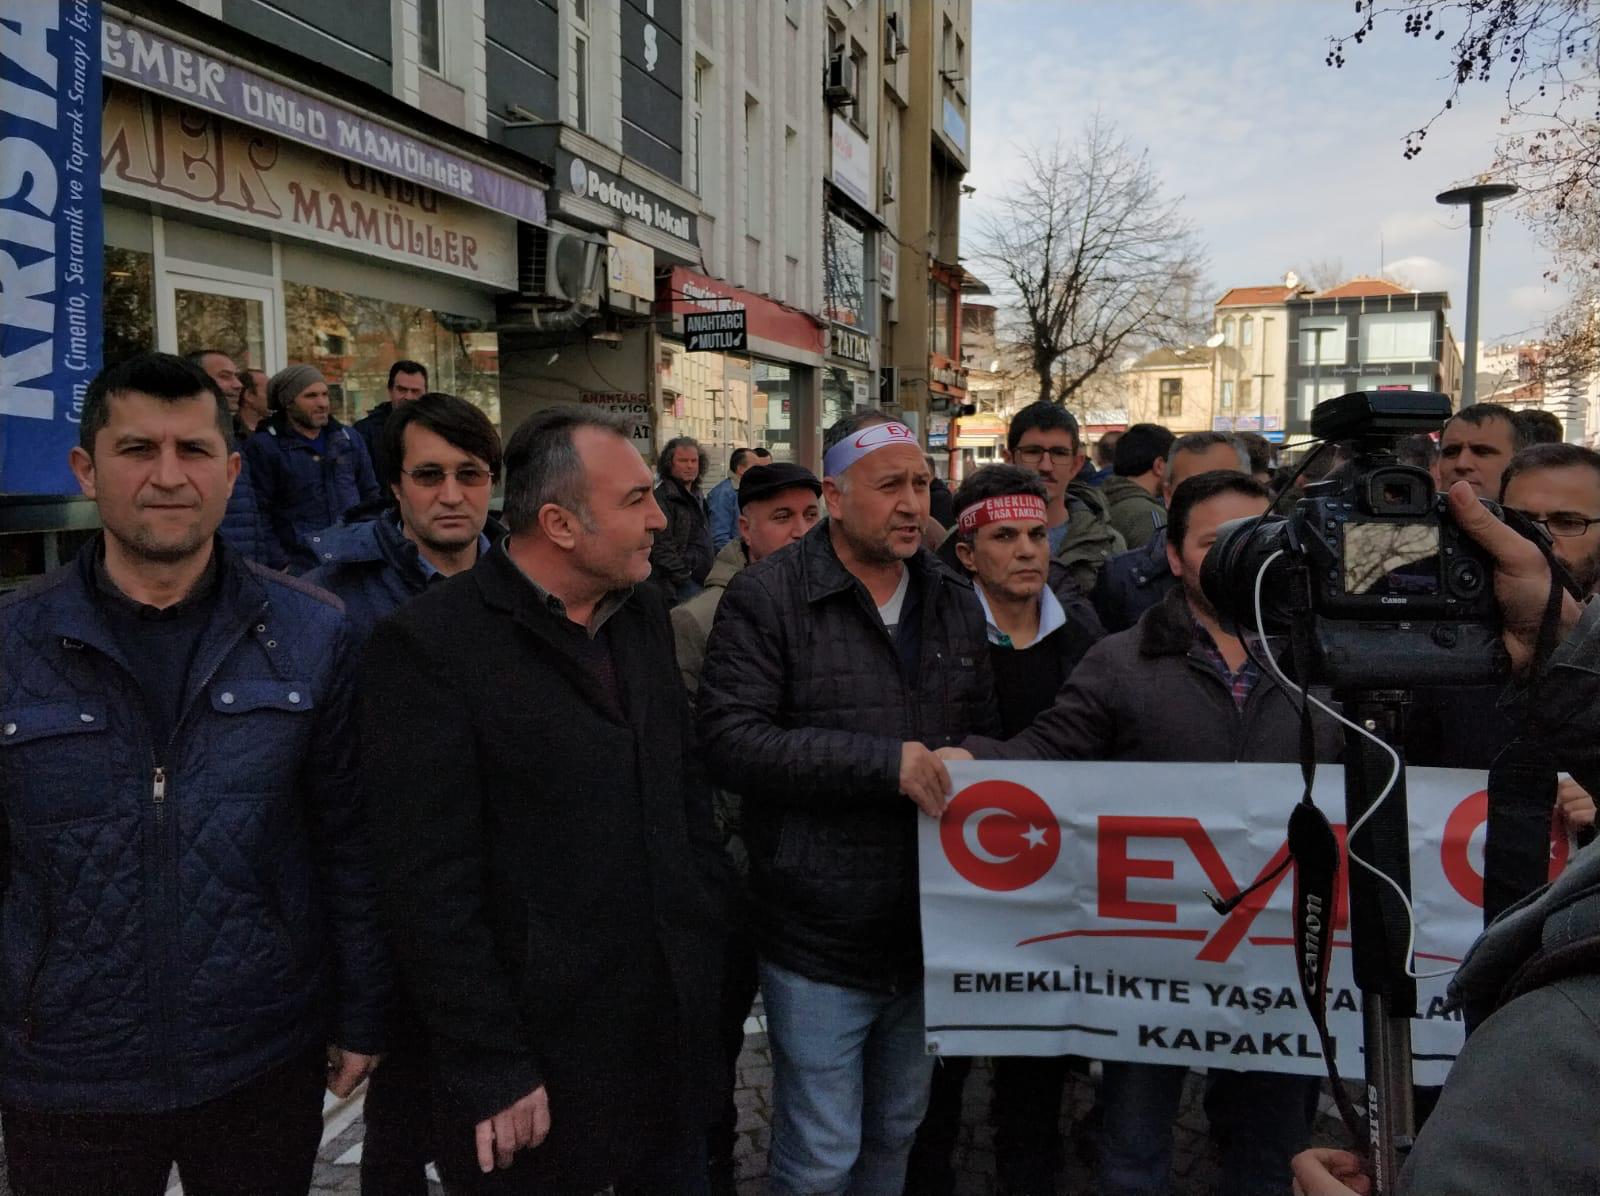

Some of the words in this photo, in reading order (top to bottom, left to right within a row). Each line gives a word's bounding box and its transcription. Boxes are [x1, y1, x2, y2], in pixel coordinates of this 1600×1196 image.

[68, 36, 91, 105] Sanayi
[66, 108, 89, 173] Toprak
[101, 21, 226, 104] EMEK
[337, 119, 474, 195] MAMÜLLER
[70, 179, 84, 200] ve
[655, 203, 690, 240] lokali
[64, 206, 84, 285] Seramik
[288, 181, 478, 271] MAMÜLLER
[64, 292, 90, 371] Çimento,
[687, 313, 743, 332] ANAHTARCI
[699, 332, 733, 348] MUTLU
[1304, 893, 1322, 996] Canon
[953, 964, 1190, 1004] EMEKLİLİKTE
[1204, 982, 1298, 1015] YAŞA
[1367, 1083, 1380, 1146] SLIK
